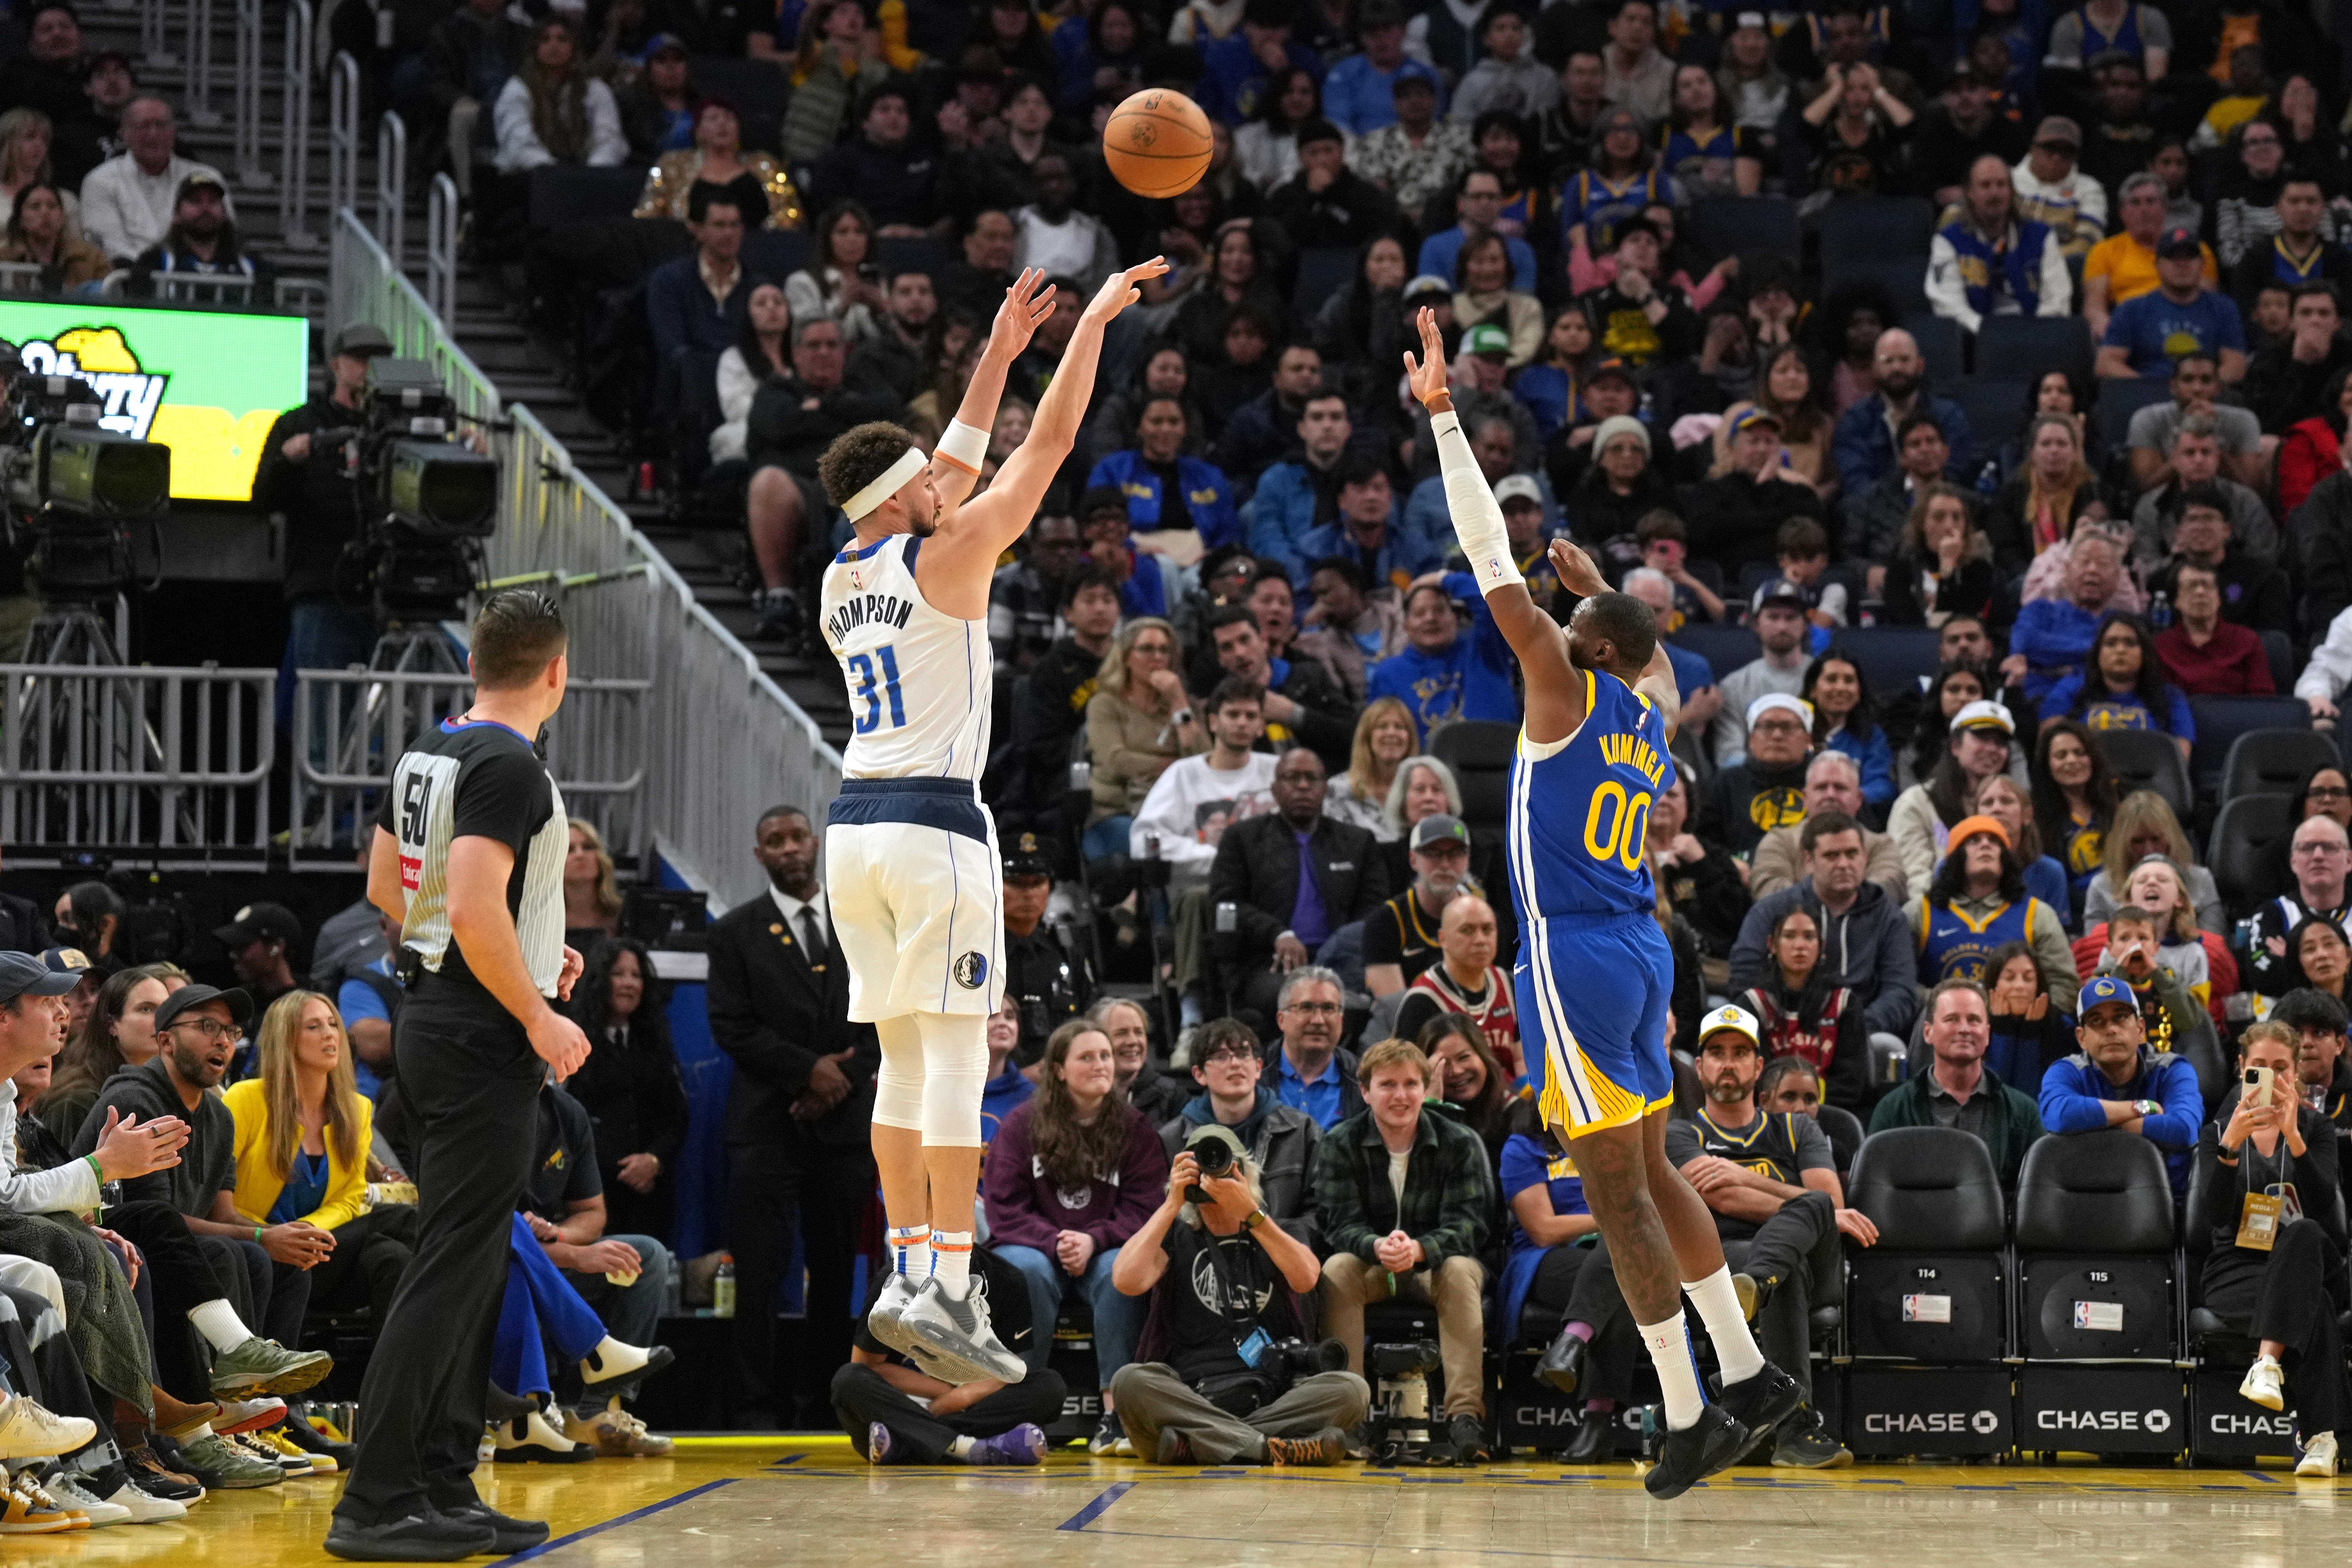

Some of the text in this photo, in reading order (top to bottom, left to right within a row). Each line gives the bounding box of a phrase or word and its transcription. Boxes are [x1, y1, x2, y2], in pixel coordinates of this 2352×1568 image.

[829, 594, 913, 645] THOMPSON
[848, 644, 907, 735] 31
[1598, 733, 1665, 789] KUMINGA
[402, 772, 433, 847] 50
[1584, 780, 1651, 871] 00
[2250, 1203, 2271, 1212] MEDIA
[1918, 1268, 1936, 1278] 114
[2090, 1272, 2108, 1282] 115
[1865, 1413, 1966, 1433] CHASE
[2037, 1410, 2139, 1430] CHASE
[2211, 1414, 2293, 1435] CHAS
